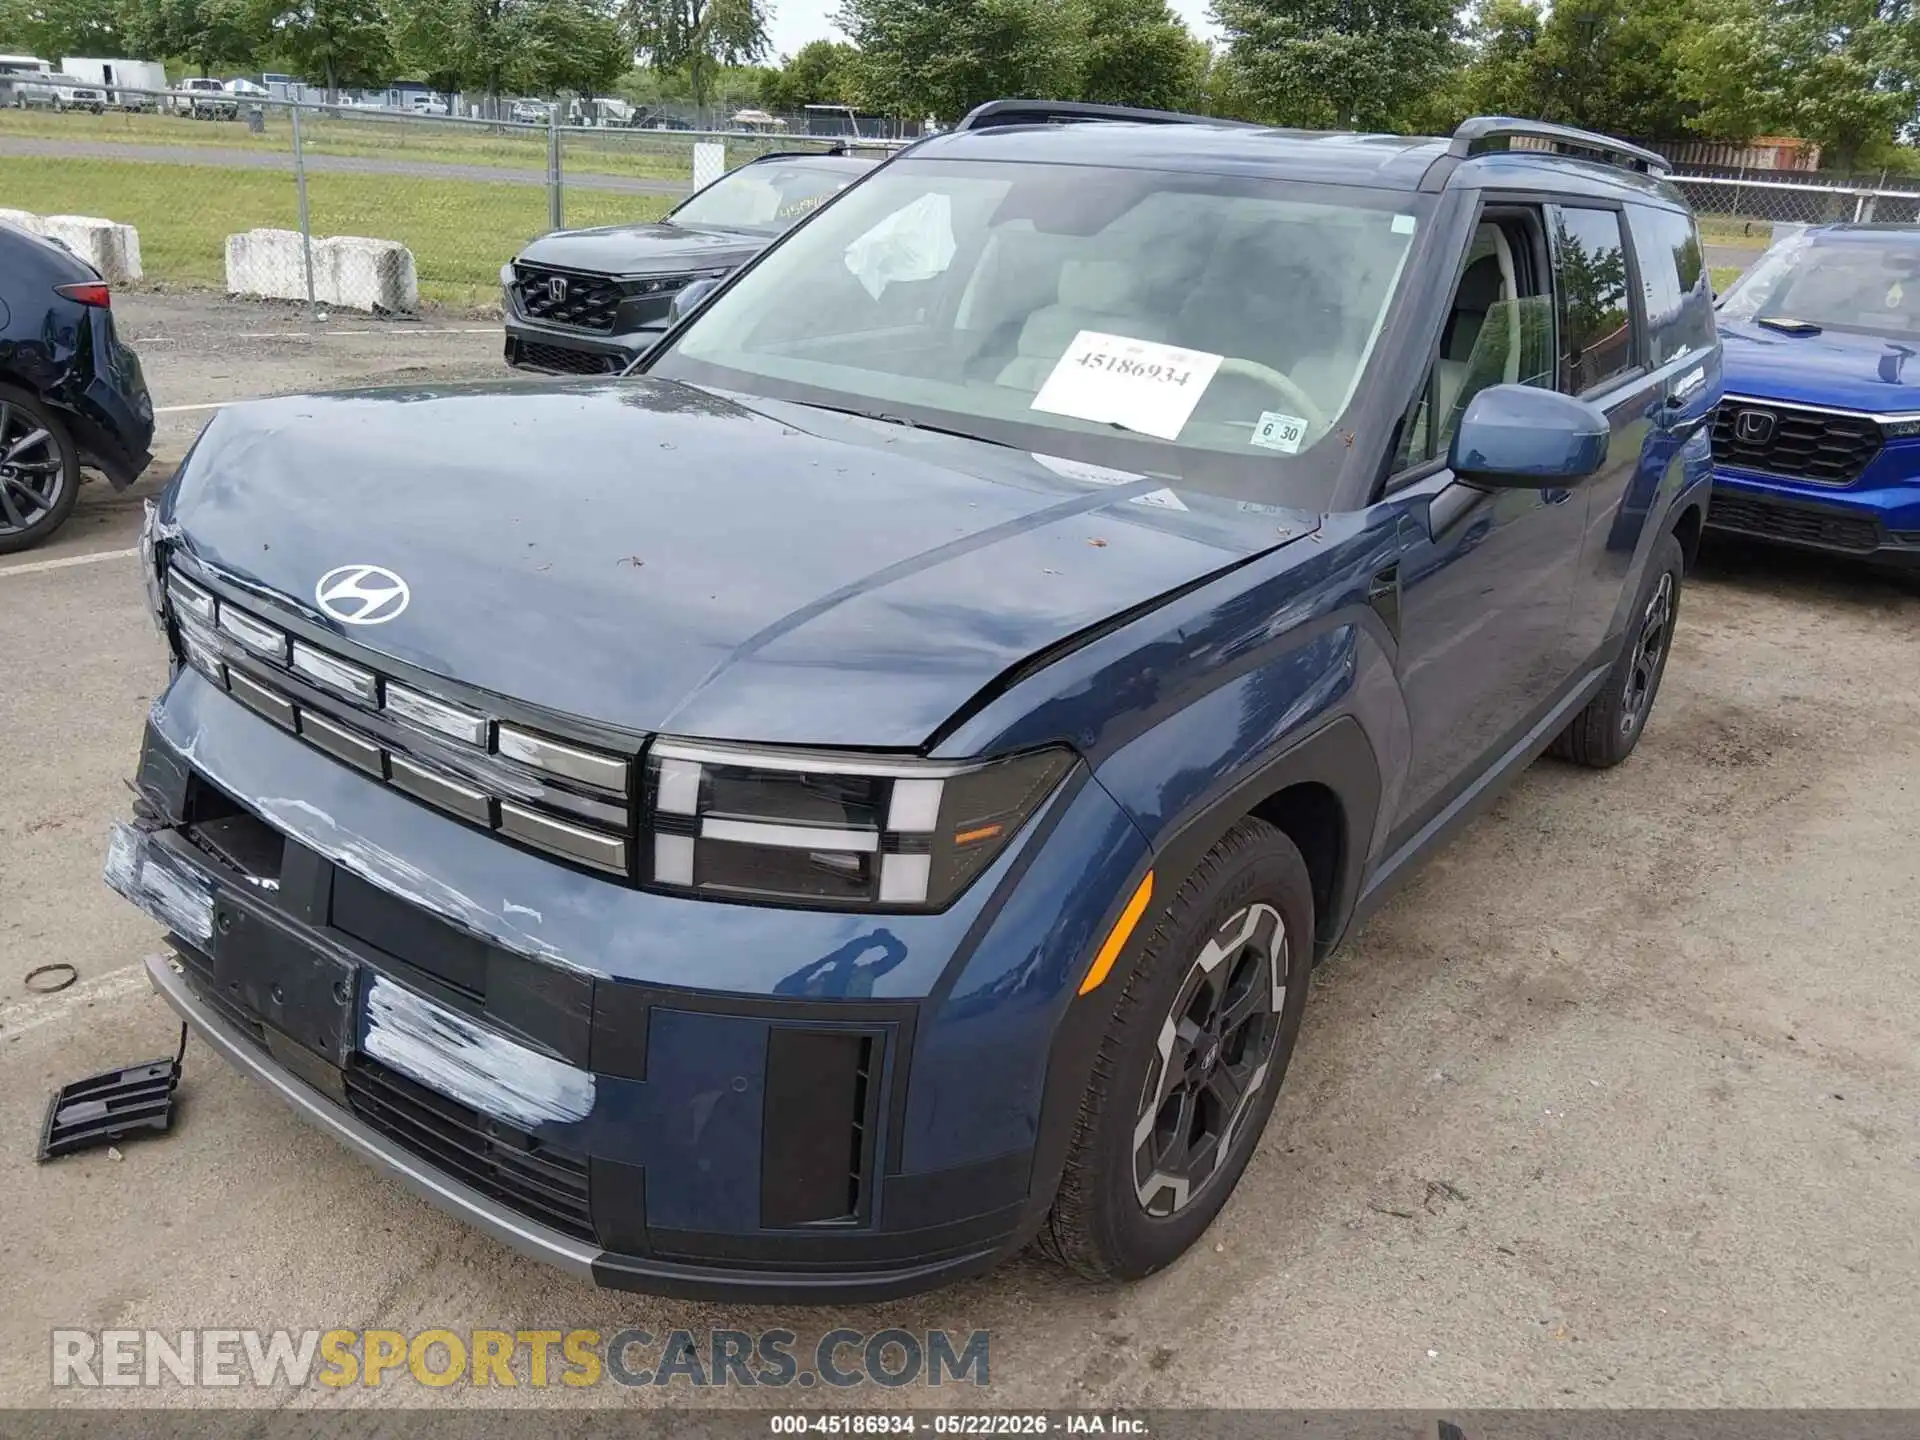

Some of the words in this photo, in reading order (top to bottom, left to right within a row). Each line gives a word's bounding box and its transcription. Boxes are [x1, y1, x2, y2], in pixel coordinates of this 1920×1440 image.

[1075, 351, 1193, 386] 45186934
[1263, 423, 1274, 436] 6
[1280, 426, 1298, 441] 30
